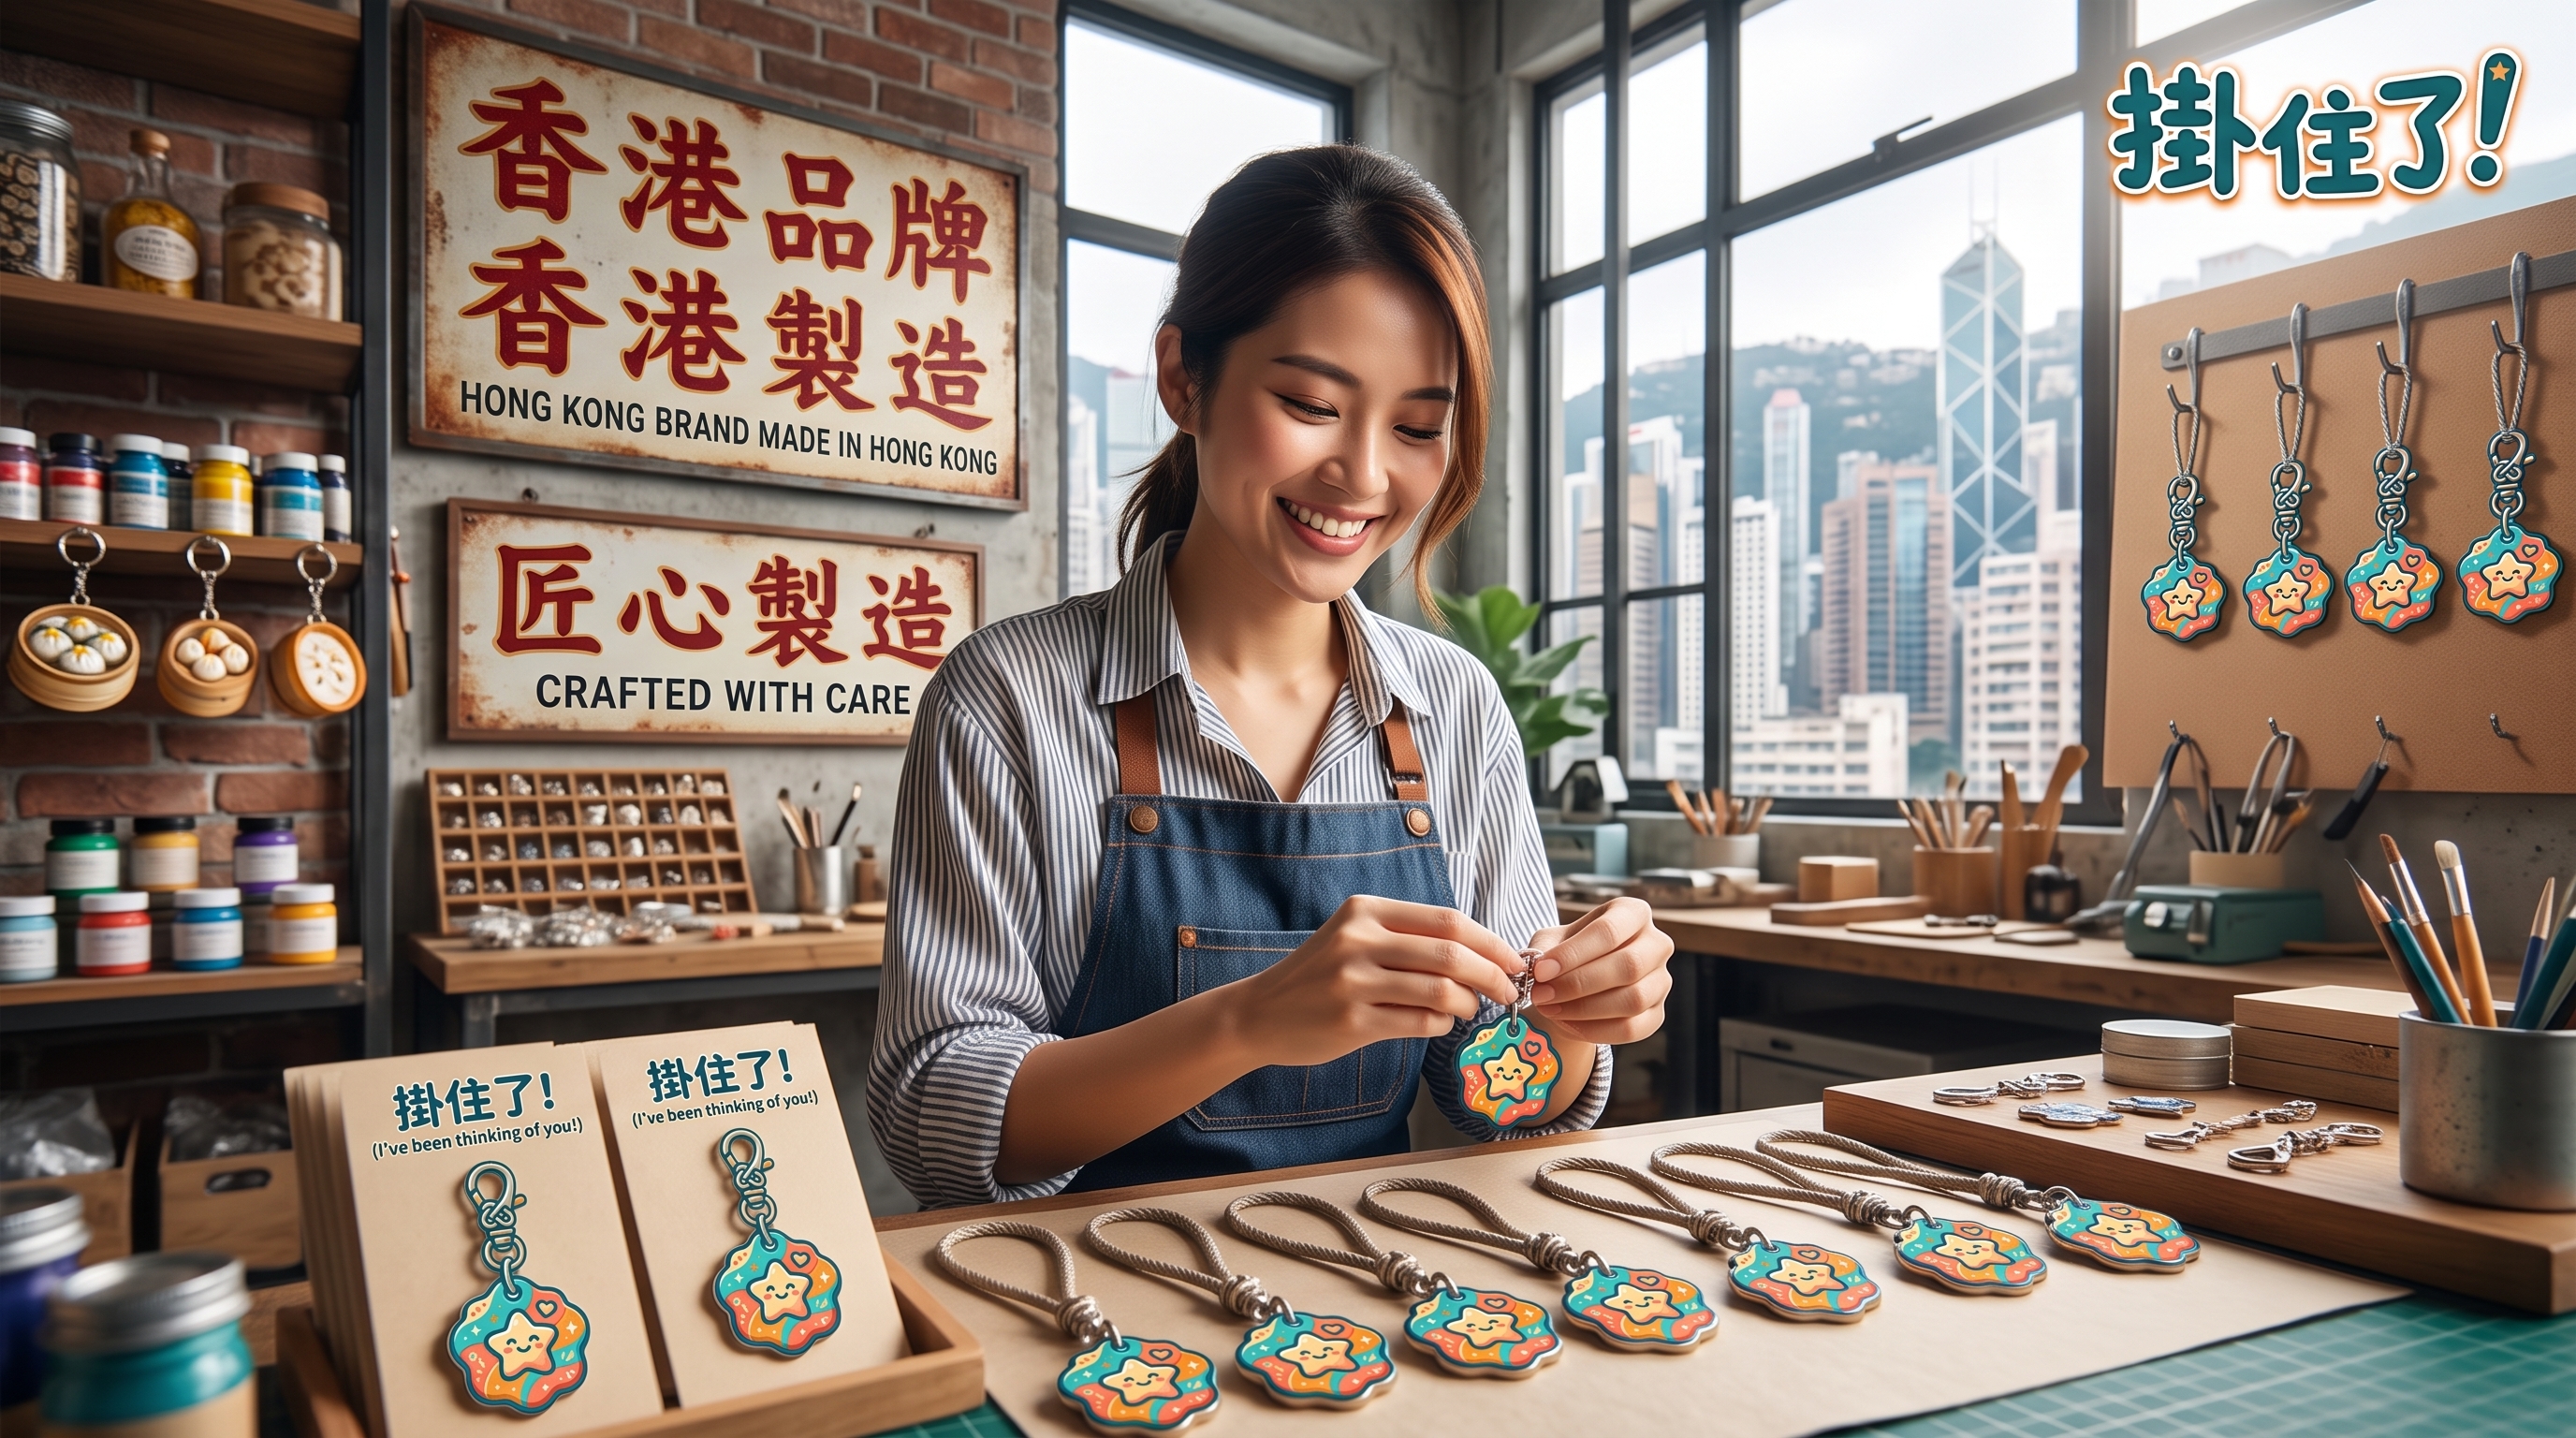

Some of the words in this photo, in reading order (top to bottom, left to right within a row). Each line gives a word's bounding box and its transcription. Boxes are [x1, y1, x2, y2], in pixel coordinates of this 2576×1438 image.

[459, 78, 992, 303] 香港品牌
[459, 236, 994, 433] 香港製造
[461, 380, 551, 422] HONG
[563, 394, 646, 433] KONG
[656, 406, 750, 445] BRAND
[759, 419, 831, 456] MADE
[839, 431, 861, 460] IN
[871, 434, 932, 468] HONG
[941, 444, 998, 476] KONG
[493, 544, 953, 670] 匠心製造
[536, 674, 711, 711] CRAFTED
[724, 680, 813, 713] WITH
[826, 682, 911, 715] CARE
[392, 1072, 555, 1132] 掛住了!
[646, 1048, 794, 1103] 掛住了!
[412, 1137, 452, 1152] been
[455, 1127, 522, 1143] thinking
[524, 1122, 540, 1137] of
[544, 1116, 583, 1138] you!)
[666, 1108, 703, 1123] been
[705, 1098, 763, 1114] thinking
[767, 1093, 781, 1108] of
[783, 1089, 819, 1110] you!)
